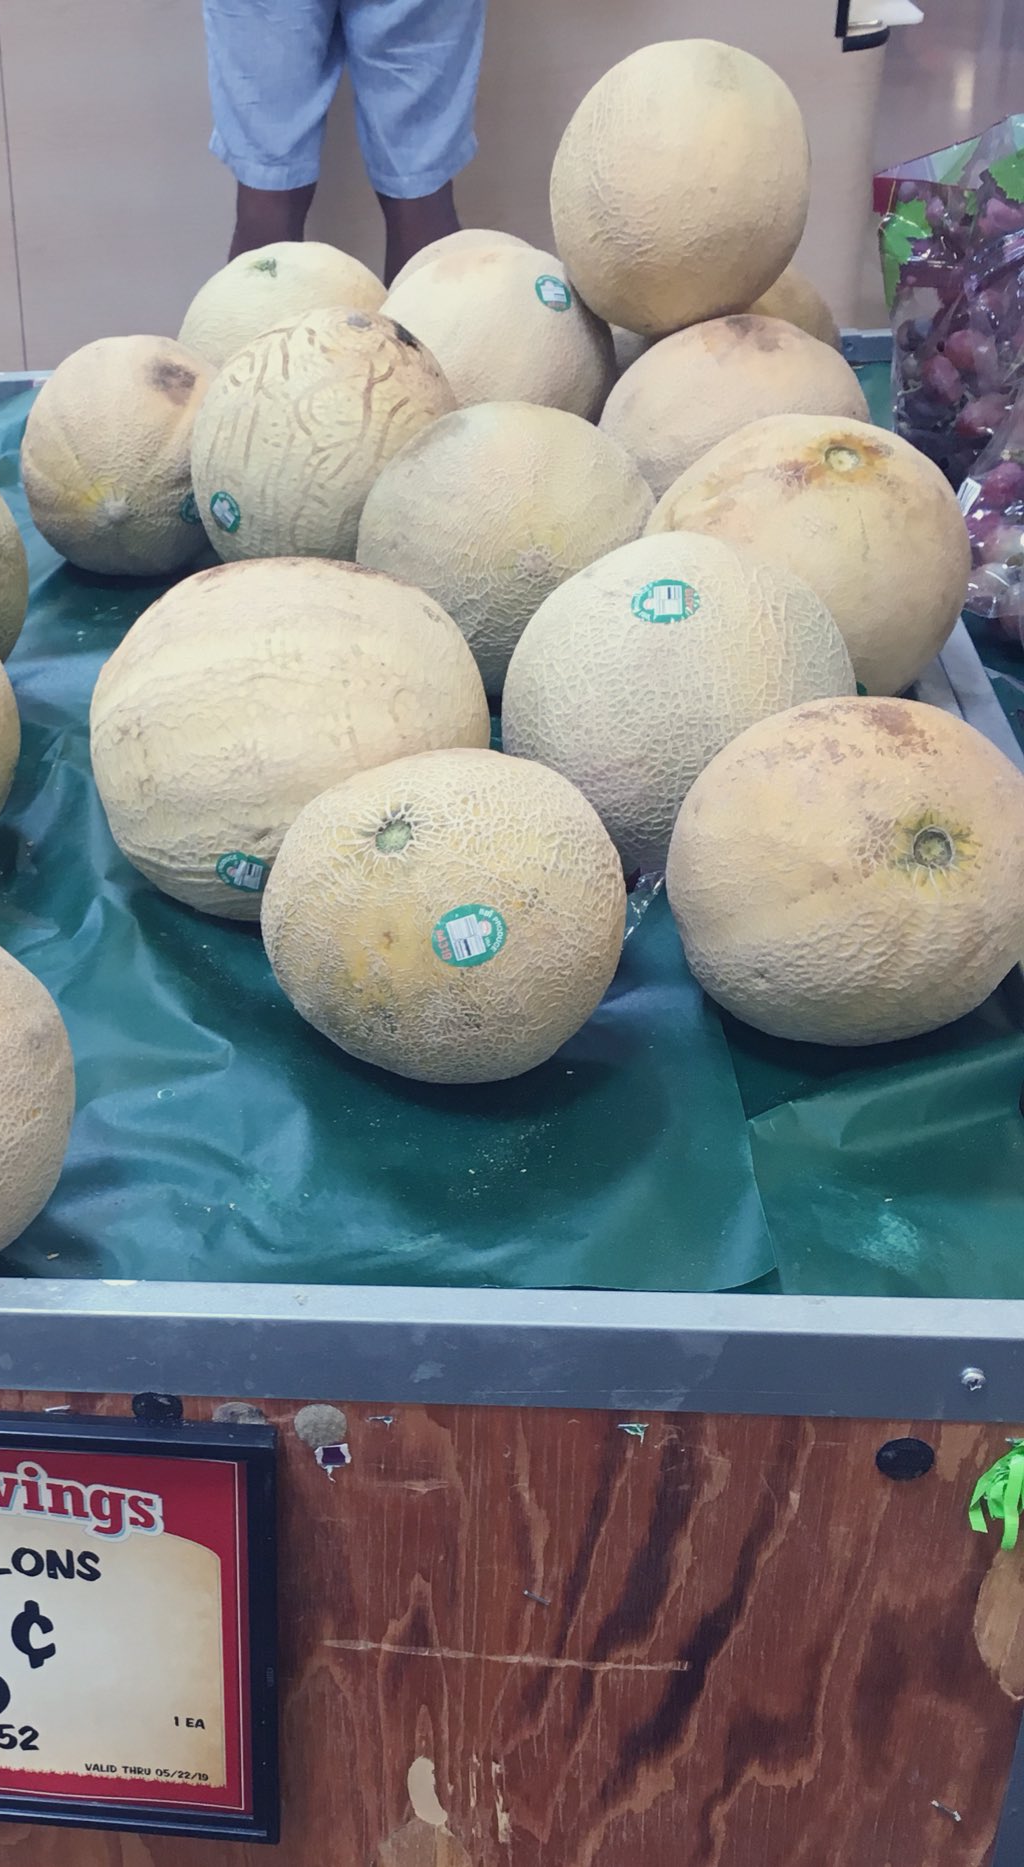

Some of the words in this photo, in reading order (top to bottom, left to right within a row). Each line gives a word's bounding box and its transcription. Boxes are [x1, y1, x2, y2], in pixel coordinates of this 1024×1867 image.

[490, 916, 504, 953] PRODUCE
[174, 1716, 180, 1727] 1
[185, 1717, 206, 1729] EA
[84, 1763, 117, 1773] VALID
[122, 1765, 151, 1776] THRU
[155, 1768, 209, 1781] 05/22/19
